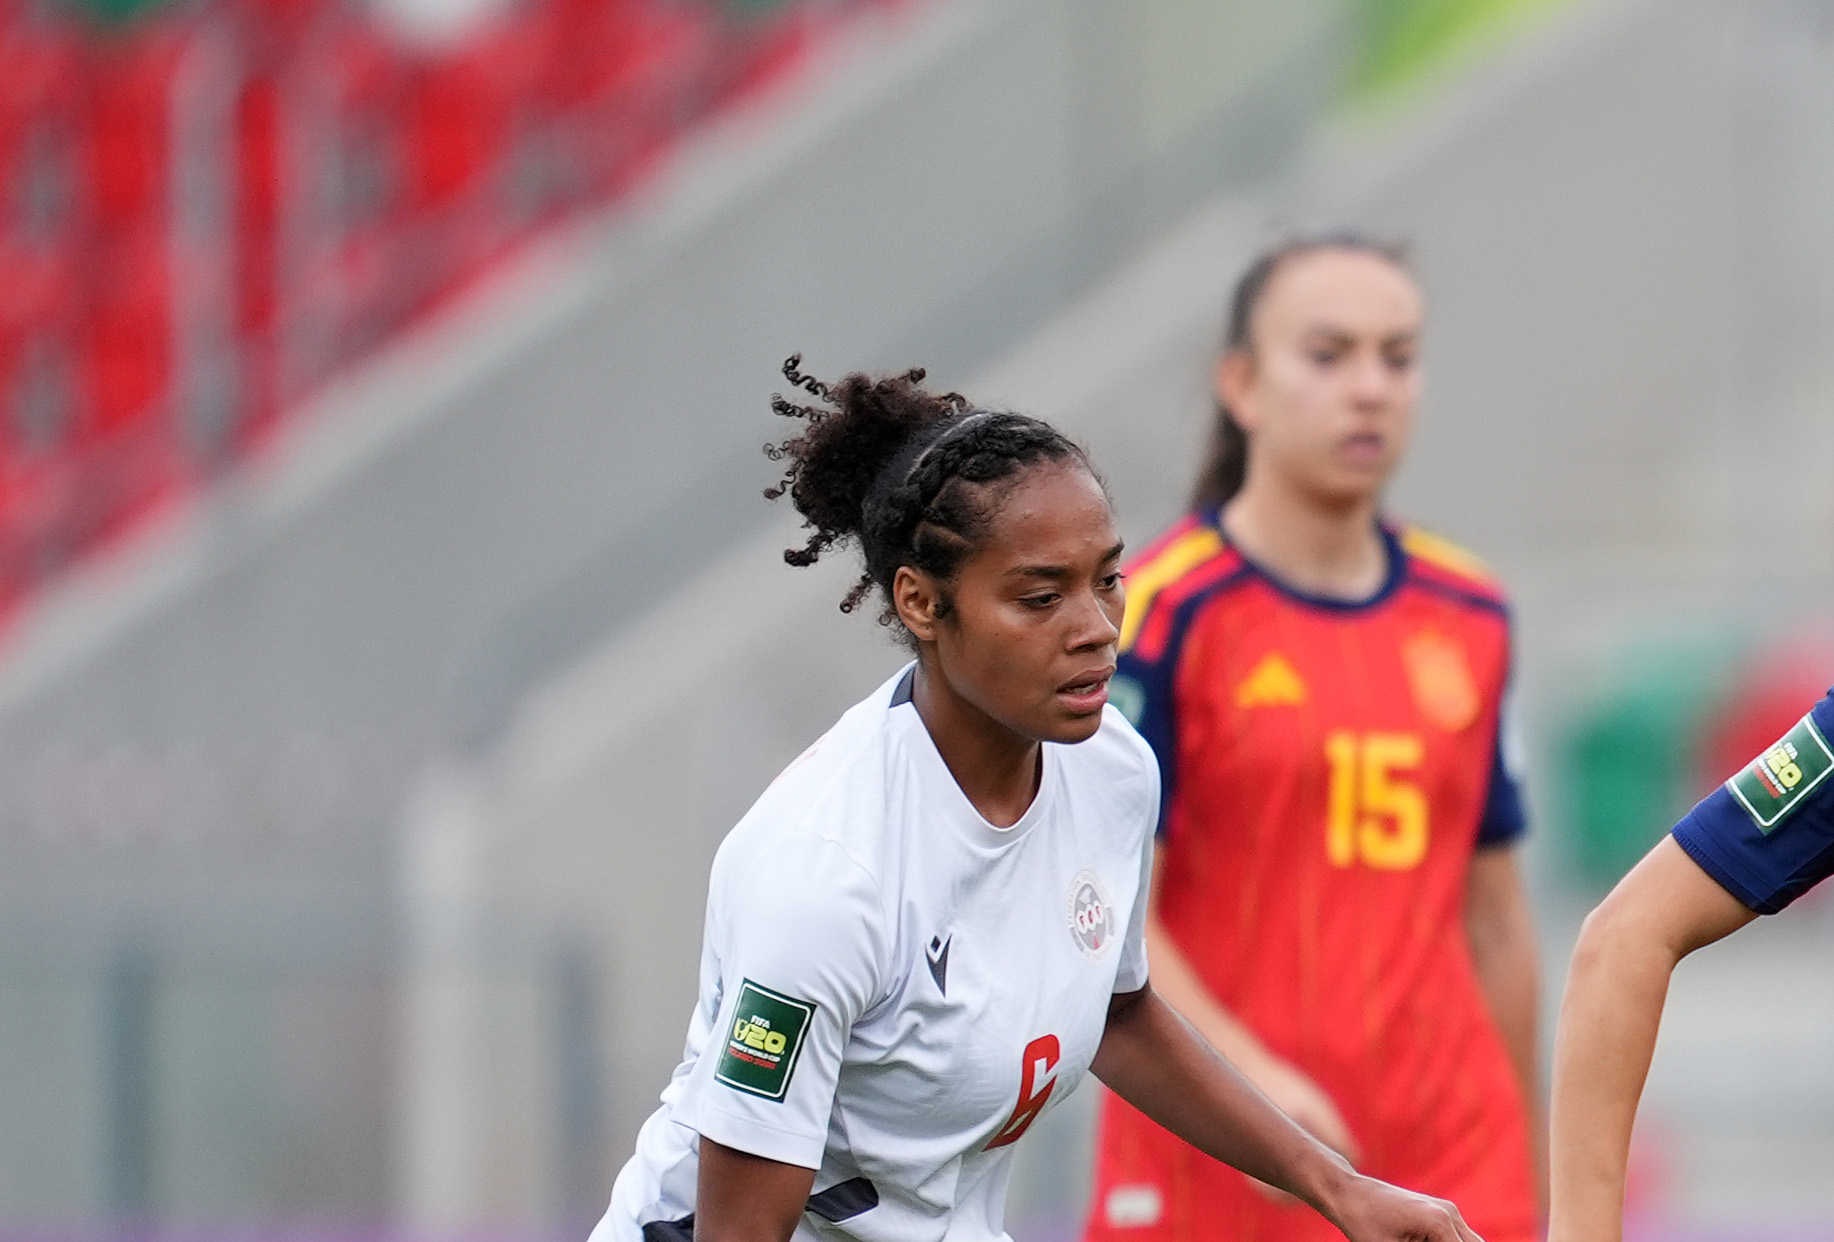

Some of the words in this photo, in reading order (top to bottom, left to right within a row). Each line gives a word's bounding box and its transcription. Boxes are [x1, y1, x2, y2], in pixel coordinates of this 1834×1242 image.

[1325, 729, 1430, 870] 15
[751, 1015, 771, 1029] FIFA
[983, 1034, 1060, 1152] 6
